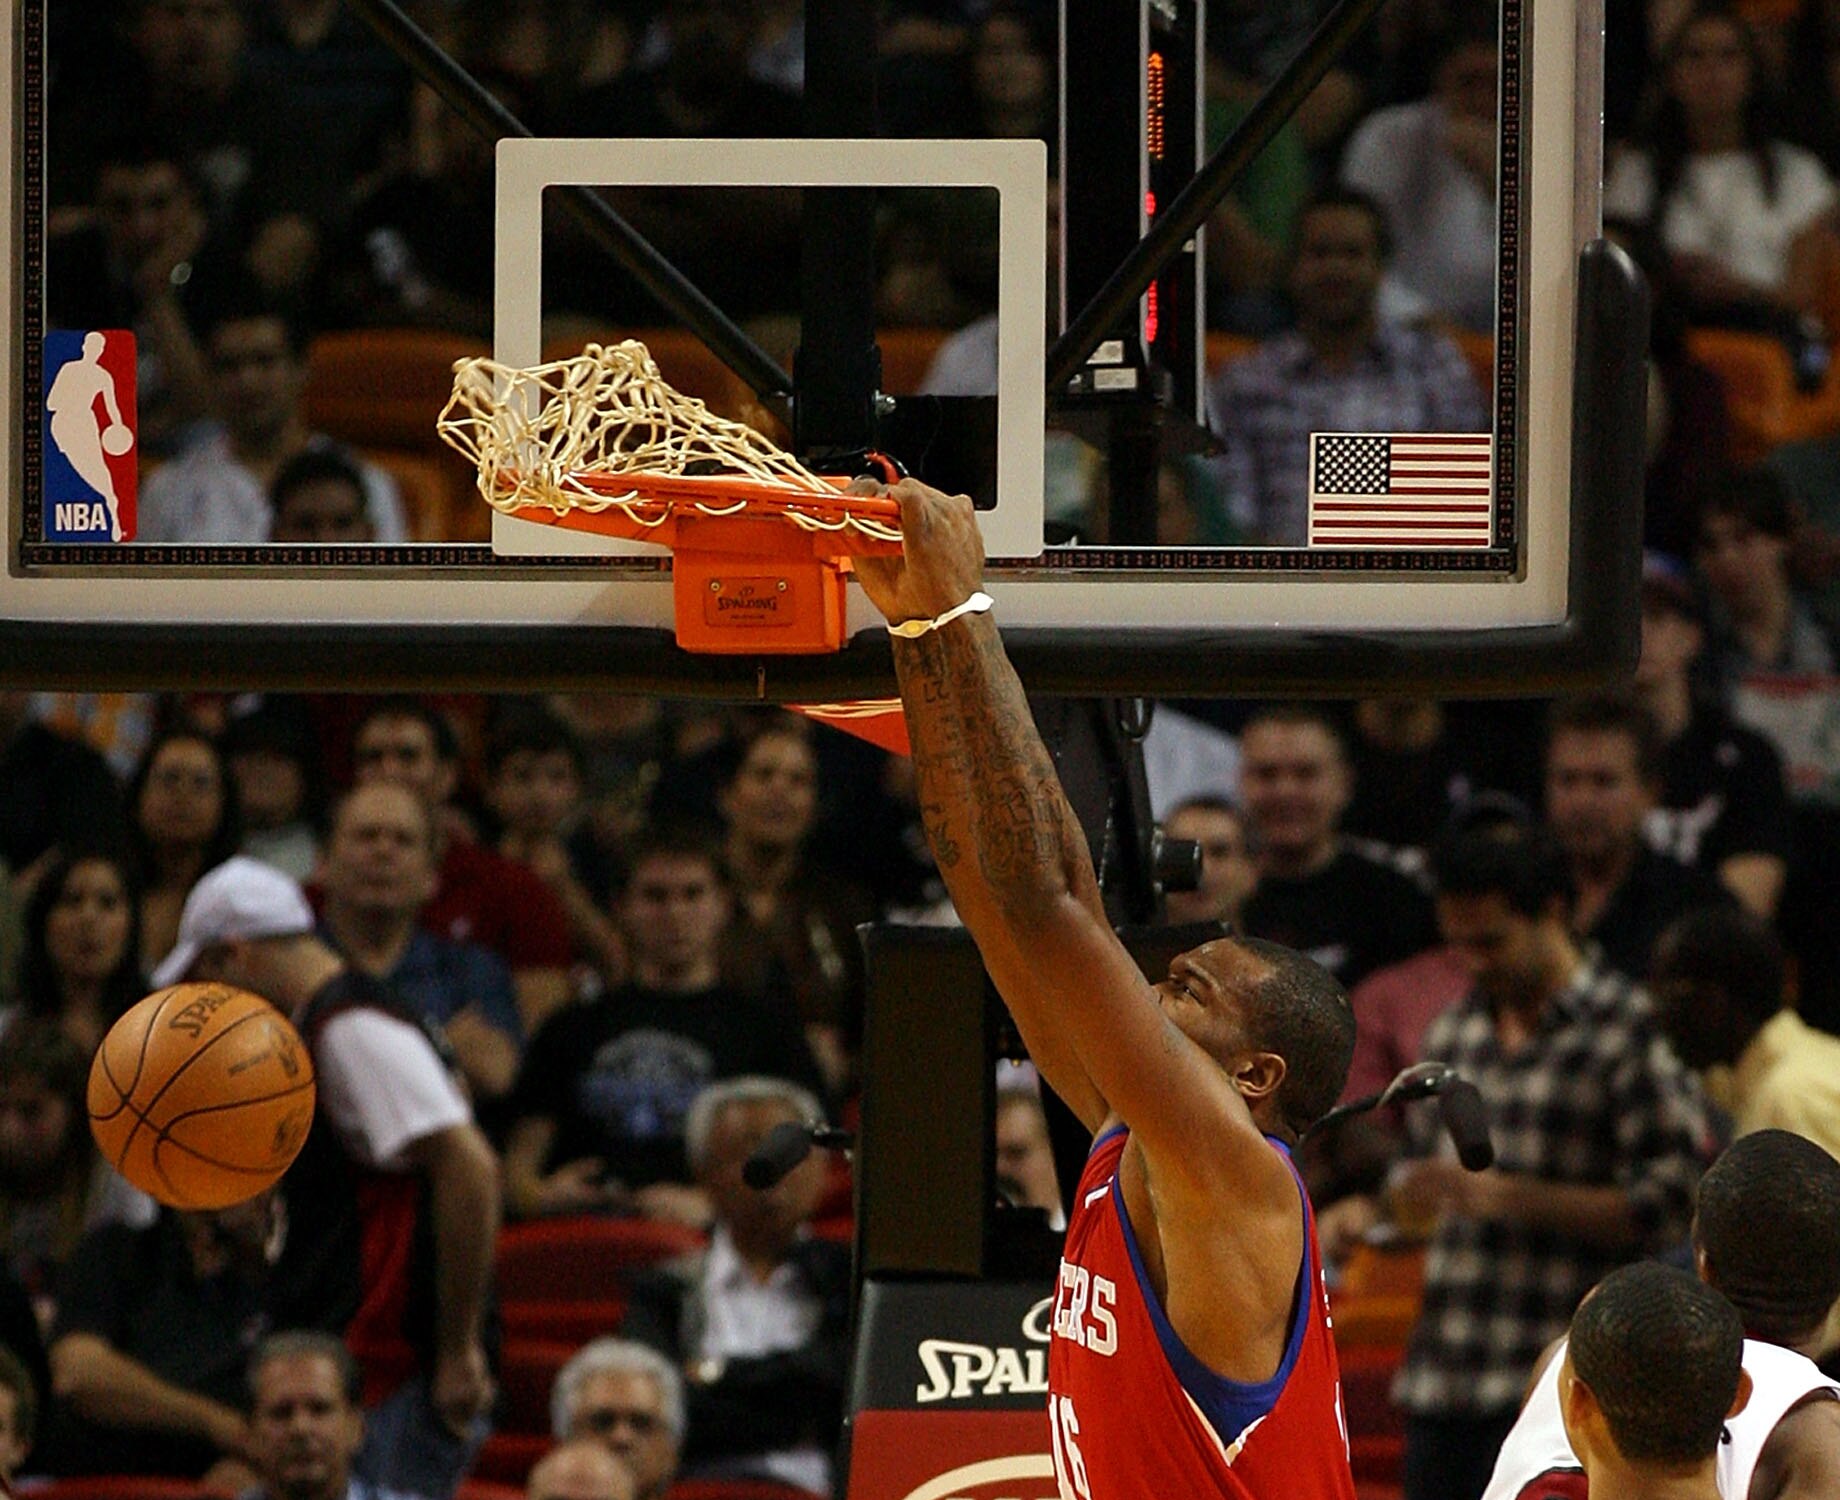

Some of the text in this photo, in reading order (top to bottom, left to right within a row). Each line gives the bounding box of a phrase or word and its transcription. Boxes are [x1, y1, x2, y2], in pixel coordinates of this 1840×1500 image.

[55, 503, 107, 531] NBA
[1053, 1257, 1117, 1356] ERS
[917, 1339, 1050, 1402] SPAL
